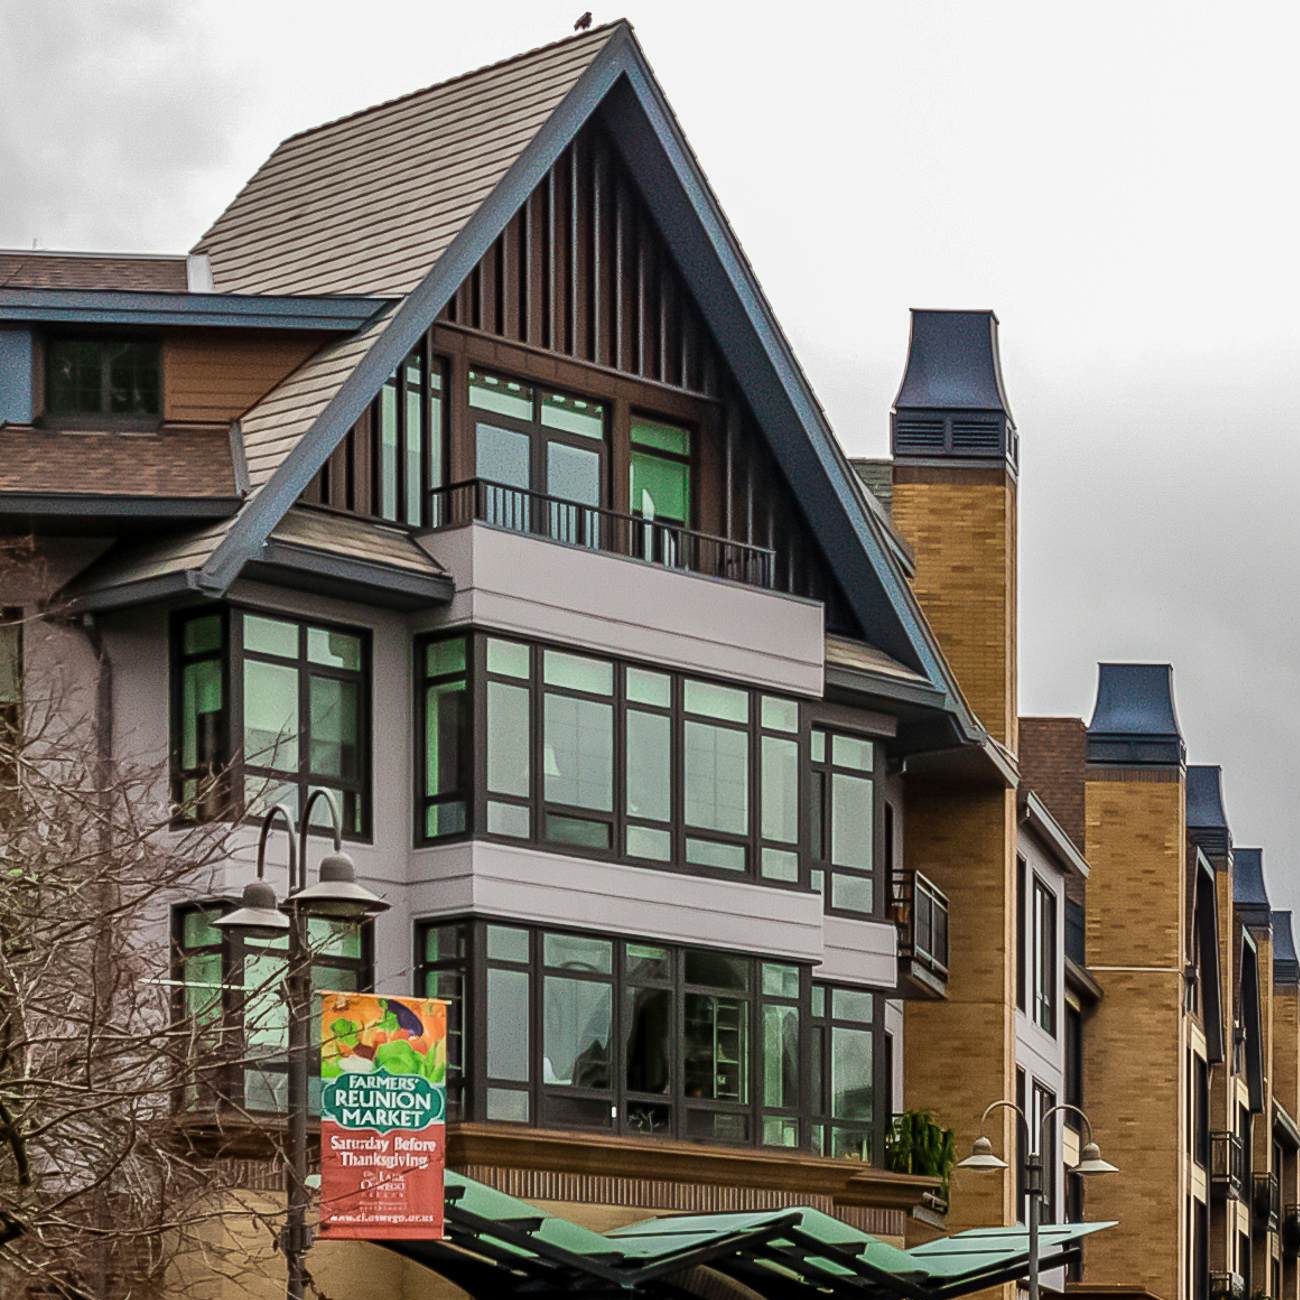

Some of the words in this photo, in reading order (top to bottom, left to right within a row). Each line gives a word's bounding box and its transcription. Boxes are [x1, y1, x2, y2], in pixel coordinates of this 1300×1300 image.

[349, 1075, 419, 1091] FARMERS'
[335, 1089, 431, 1110] REUNION
[342, 1108, 425, 1127] MARKET
[331, 1135, 389, 1152] Saturday
[394, 1136, 436, 1152] Before
[340, 1151, 429, 1169] Thanksgiving
